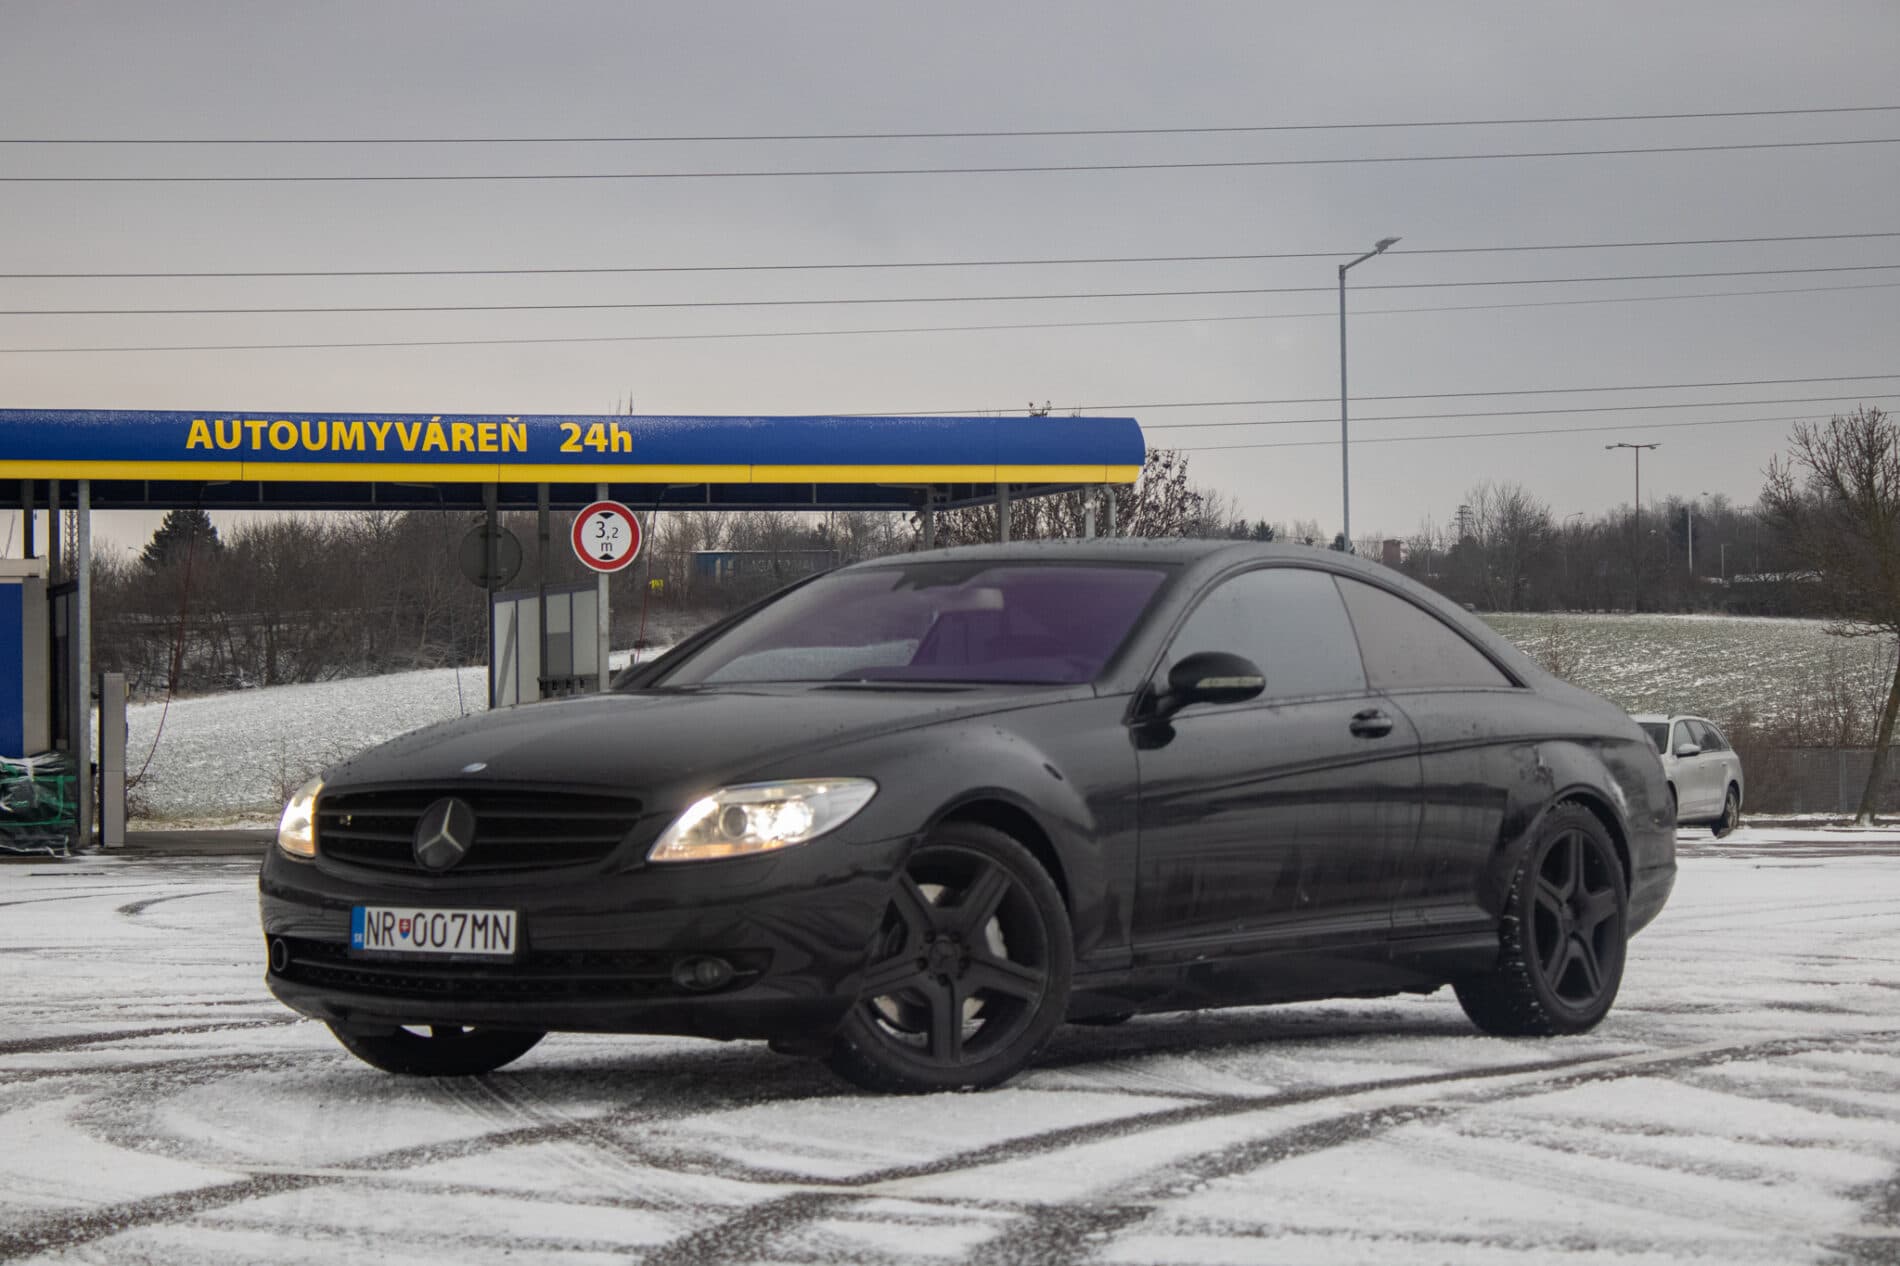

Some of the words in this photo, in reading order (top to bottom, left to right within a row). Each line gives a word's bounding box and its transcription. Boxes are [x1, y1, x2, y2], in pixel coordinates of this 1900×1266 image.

[185, 416, 528, 452] AUTOUMYVÁREŇ
[559, 422, 633, 452] 24h
[595, 520, 619, 540] 3,2
[600, 541, 613, 552] m
